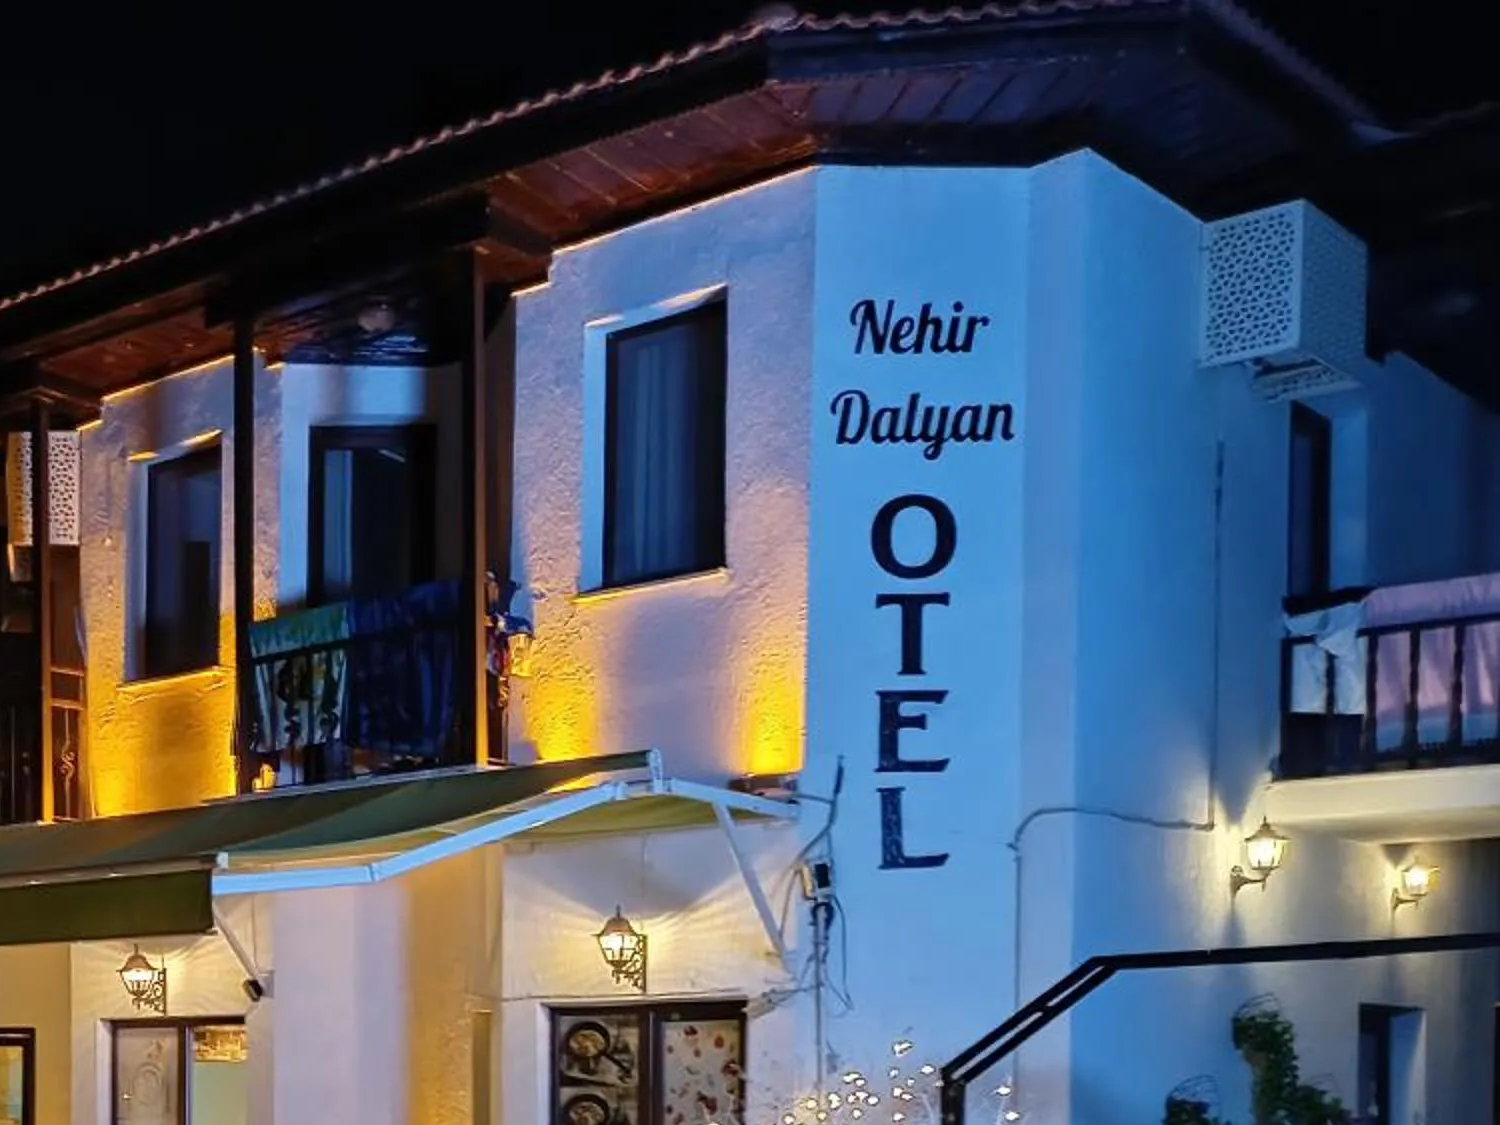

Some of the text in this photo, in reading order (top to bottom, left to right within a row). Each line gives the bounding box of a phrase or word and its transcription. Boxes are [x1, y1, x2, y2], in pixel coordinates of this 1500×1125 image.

[849, 299, 989, 355] Nehir
[829, 389, 1015, 461] Dalyan
[870, 493, 958, 871] OTEL
